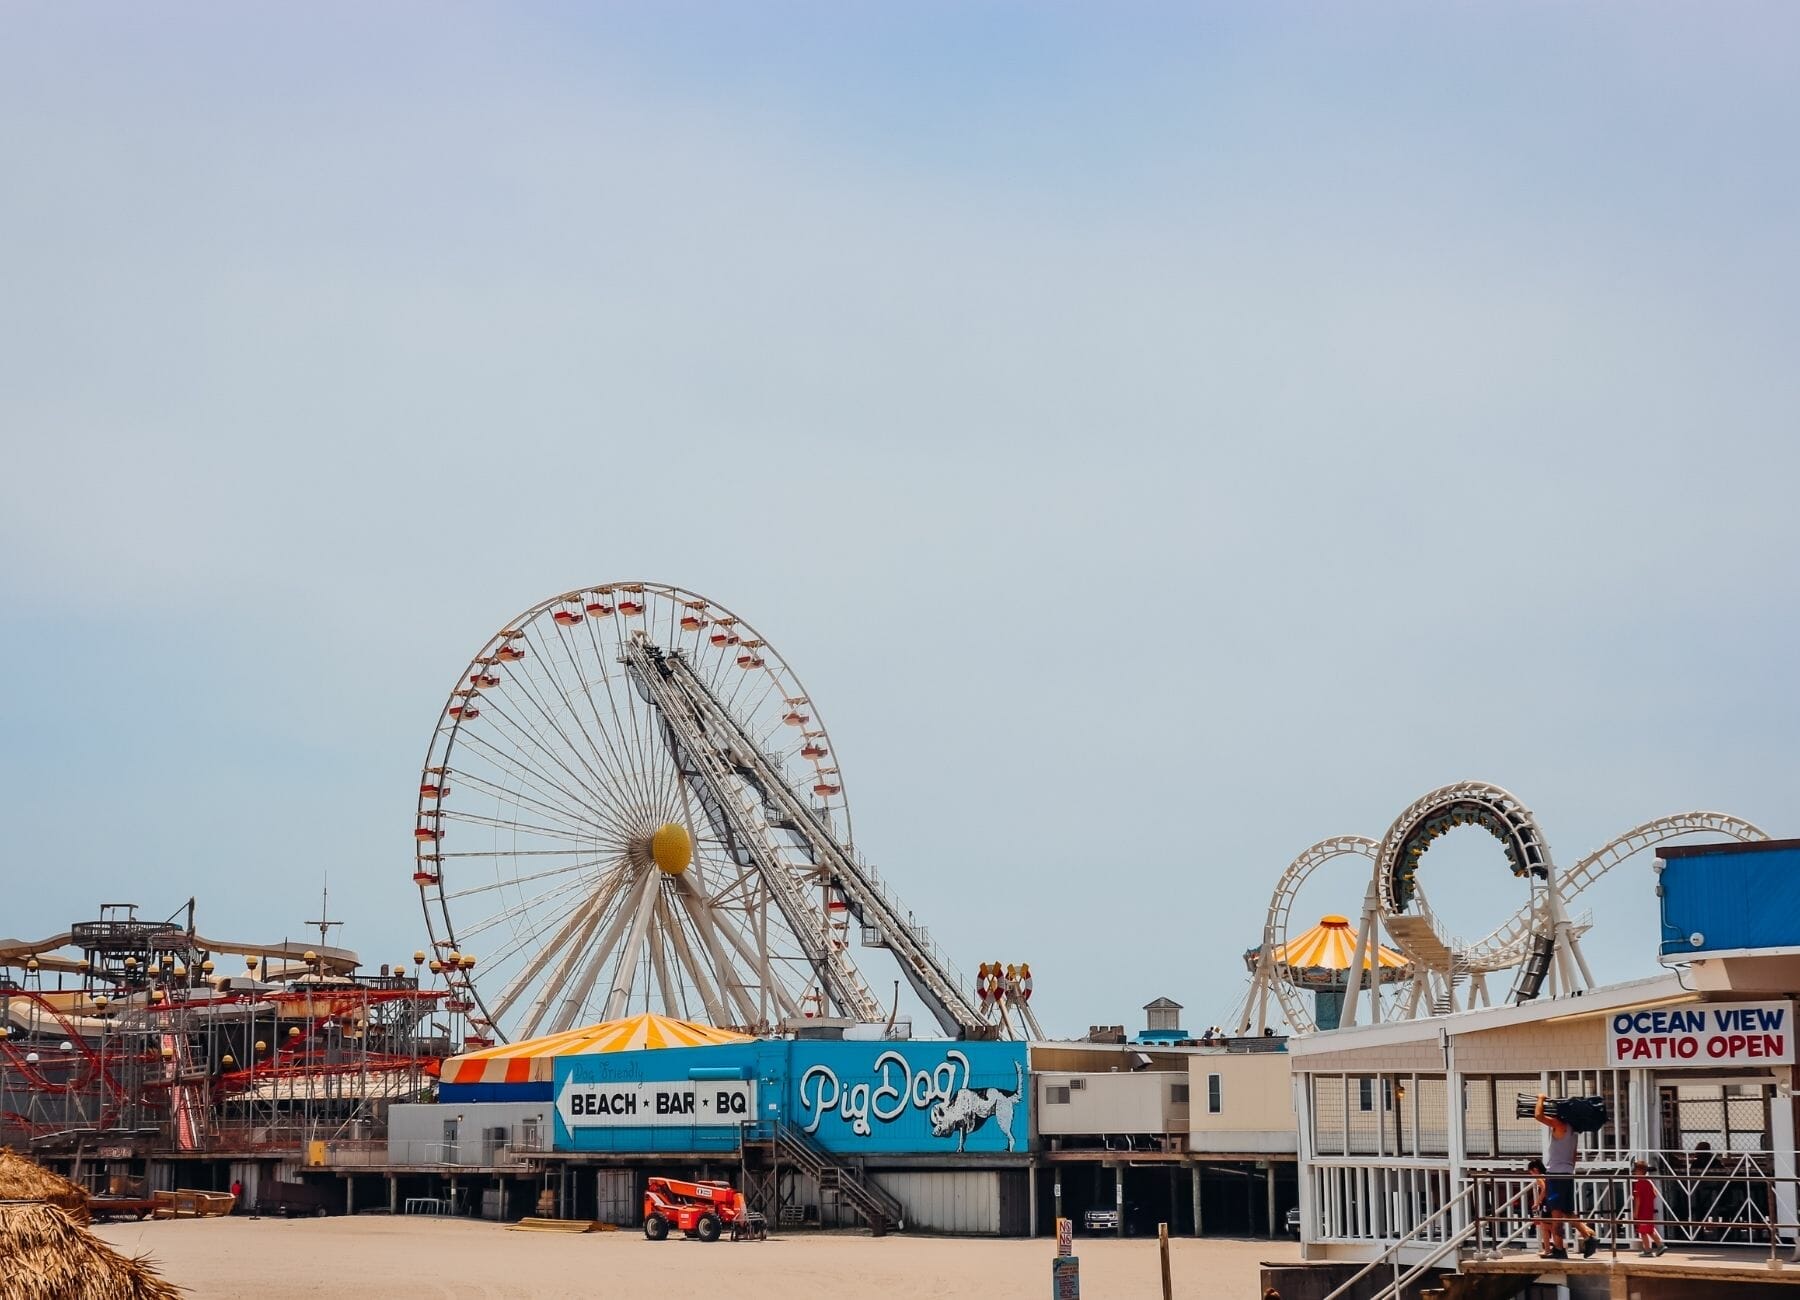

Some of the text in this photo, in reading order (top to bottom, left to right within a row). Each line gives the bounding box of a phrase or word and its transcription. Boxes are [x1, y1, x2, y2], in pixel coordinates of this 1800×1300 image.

[1613, 1008, 1784, 1034] OCEAN VIEW
[1616, 1034, 1783, 1060] PATIO OPEN
[575, 1063, 595, 1089] Dog
[571, 1092, 747, 1115] BEACH BAR BQ
